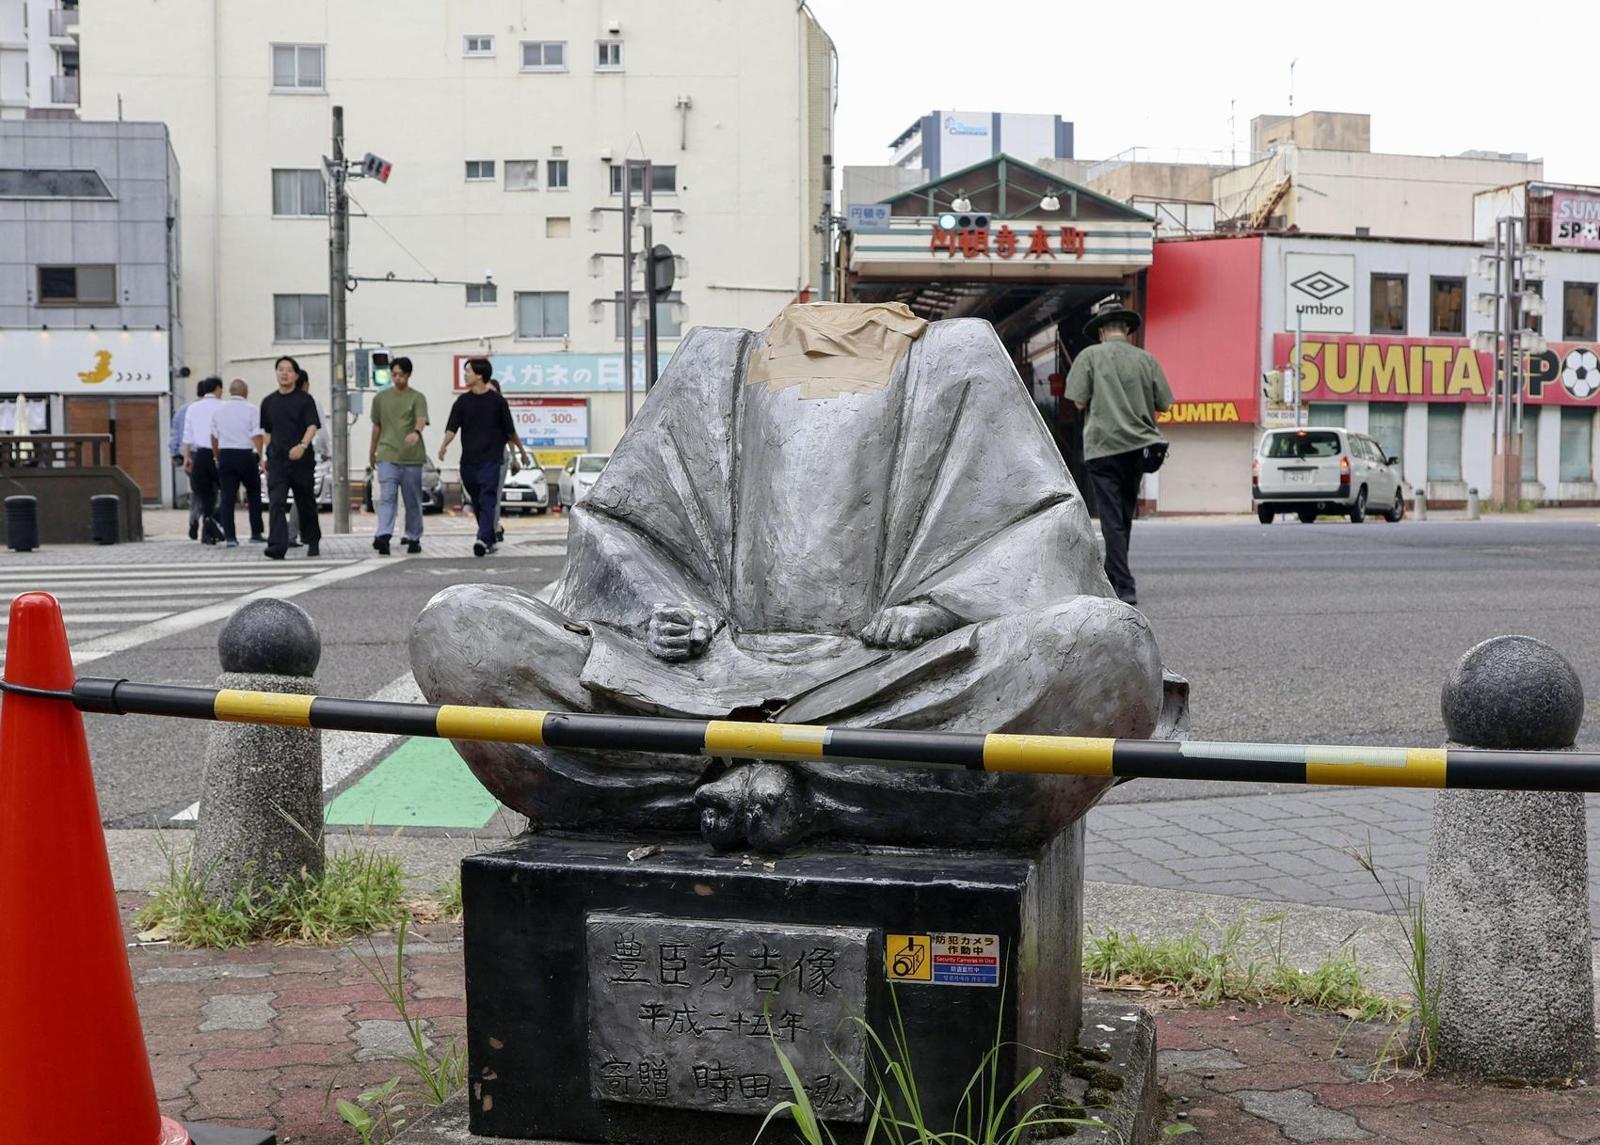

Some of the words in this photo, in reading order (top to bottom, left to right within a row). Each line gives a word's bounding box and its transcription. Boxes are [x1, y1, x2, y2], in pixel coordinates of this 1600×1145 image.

[1296, 303, 1344, 316] umbro
[1289, 341, 1487, 396] SUMITA
[1157, 402, 1239, 422] SUMITA
[935, 935, 994, 946] 防犯カメラ
[947, 946, 983, 955] 作動中
[609, 932, 841, 996] 豊臣秀吉像
[638, 1001, 810, 1043] 平成二十五年
[600, 1055, 669, 1100] 寄贈
